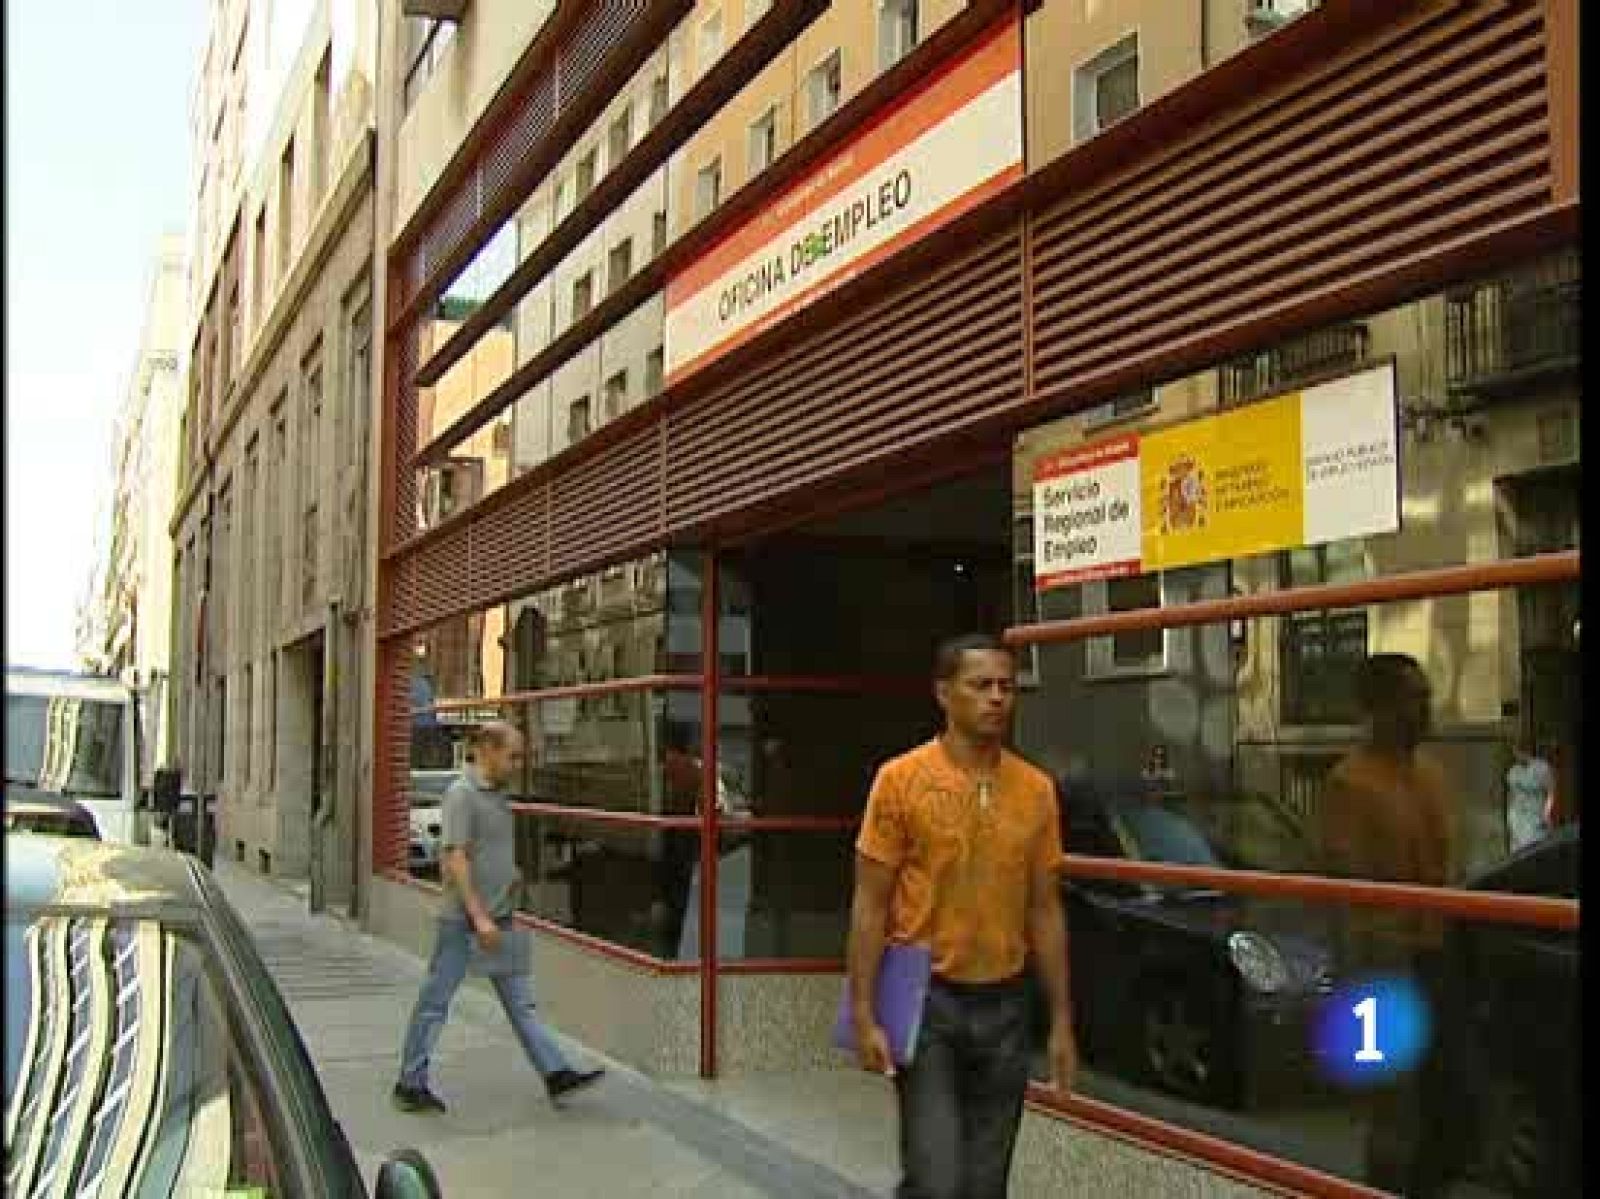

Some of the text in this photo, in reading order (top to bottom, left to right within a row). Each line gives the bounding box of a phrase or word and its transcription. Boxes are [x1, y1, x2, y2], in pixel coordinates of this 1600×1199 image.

[718, 254, 787, 321] OFICINA
[822, 169, 912, 255] EMPLEO
[1043, 482, 1101, 509] Servicio
[1043, 498, 1130, 537] Regional de
[1043, 535, 1098, 562] Empleo
